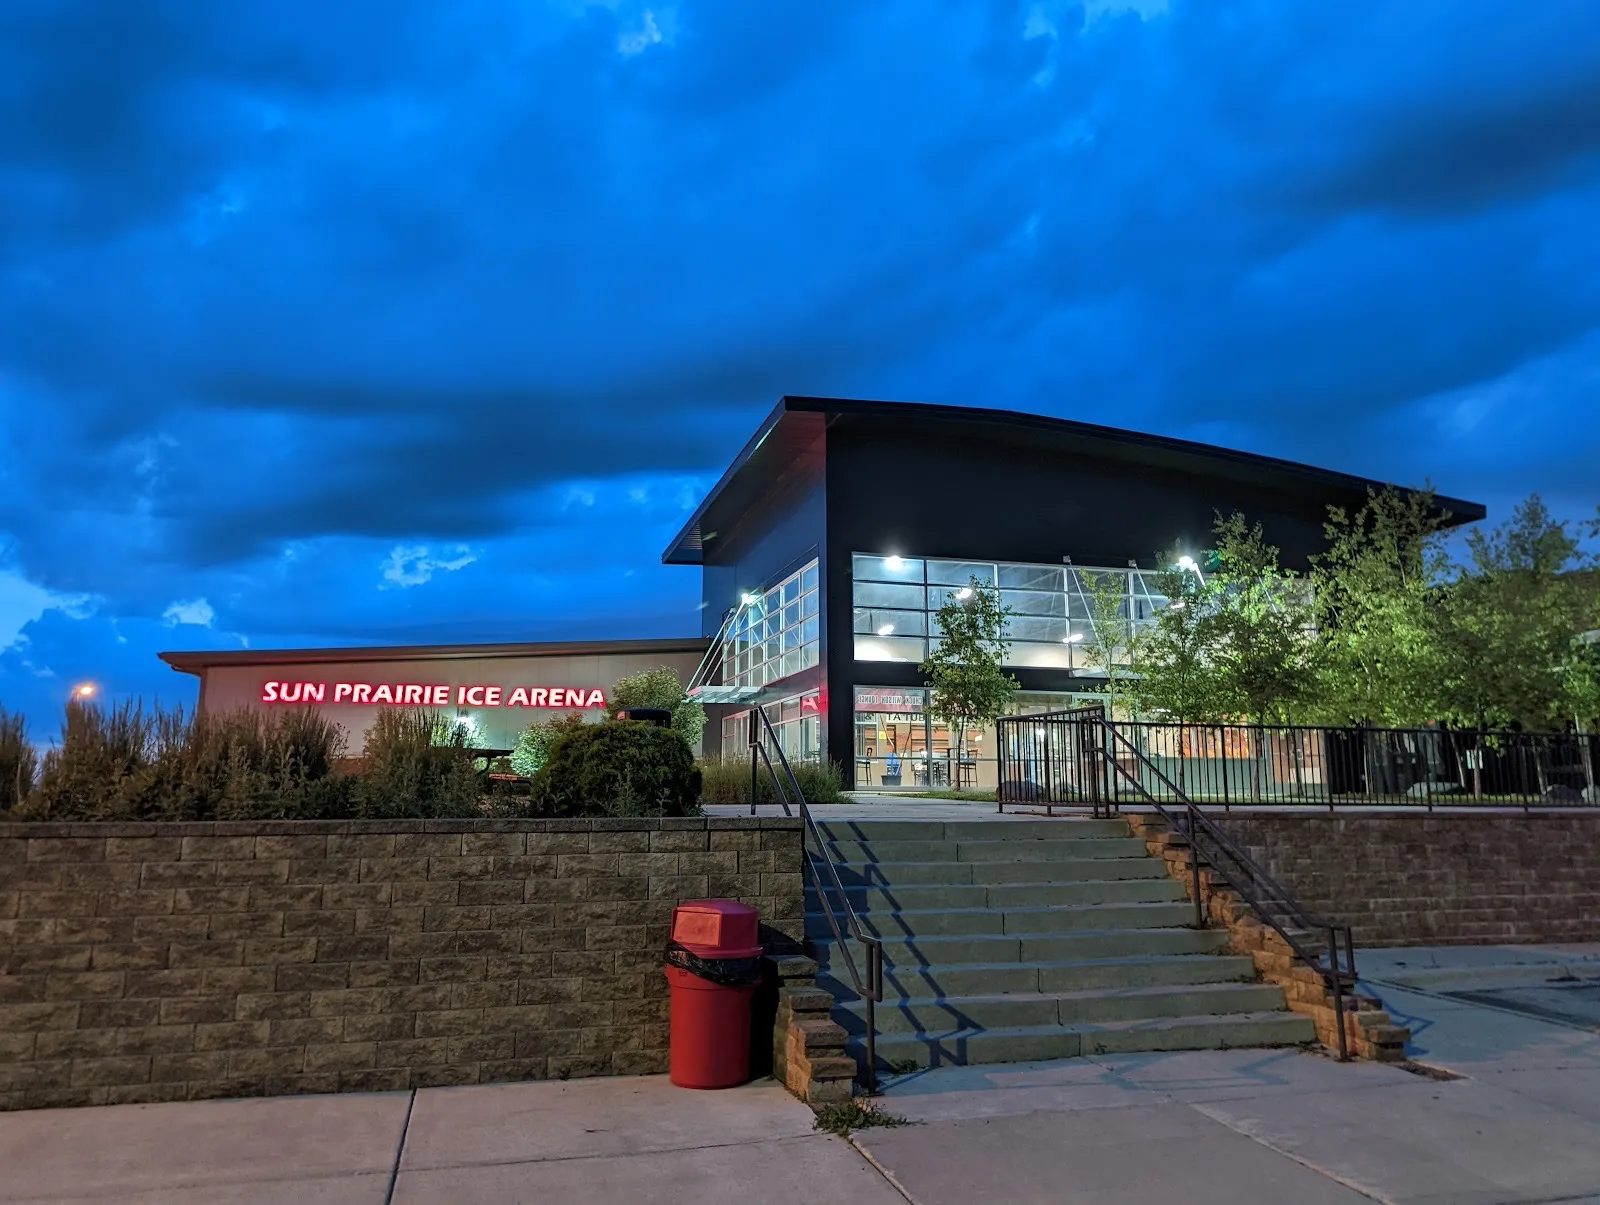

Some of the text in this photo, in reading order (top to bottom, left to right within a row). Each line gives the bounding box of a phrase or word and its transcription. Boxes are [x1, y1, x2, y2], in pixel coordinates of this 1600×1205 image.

[263, 681, 605, 709] SUN PRAIRIE ICE ARENA
